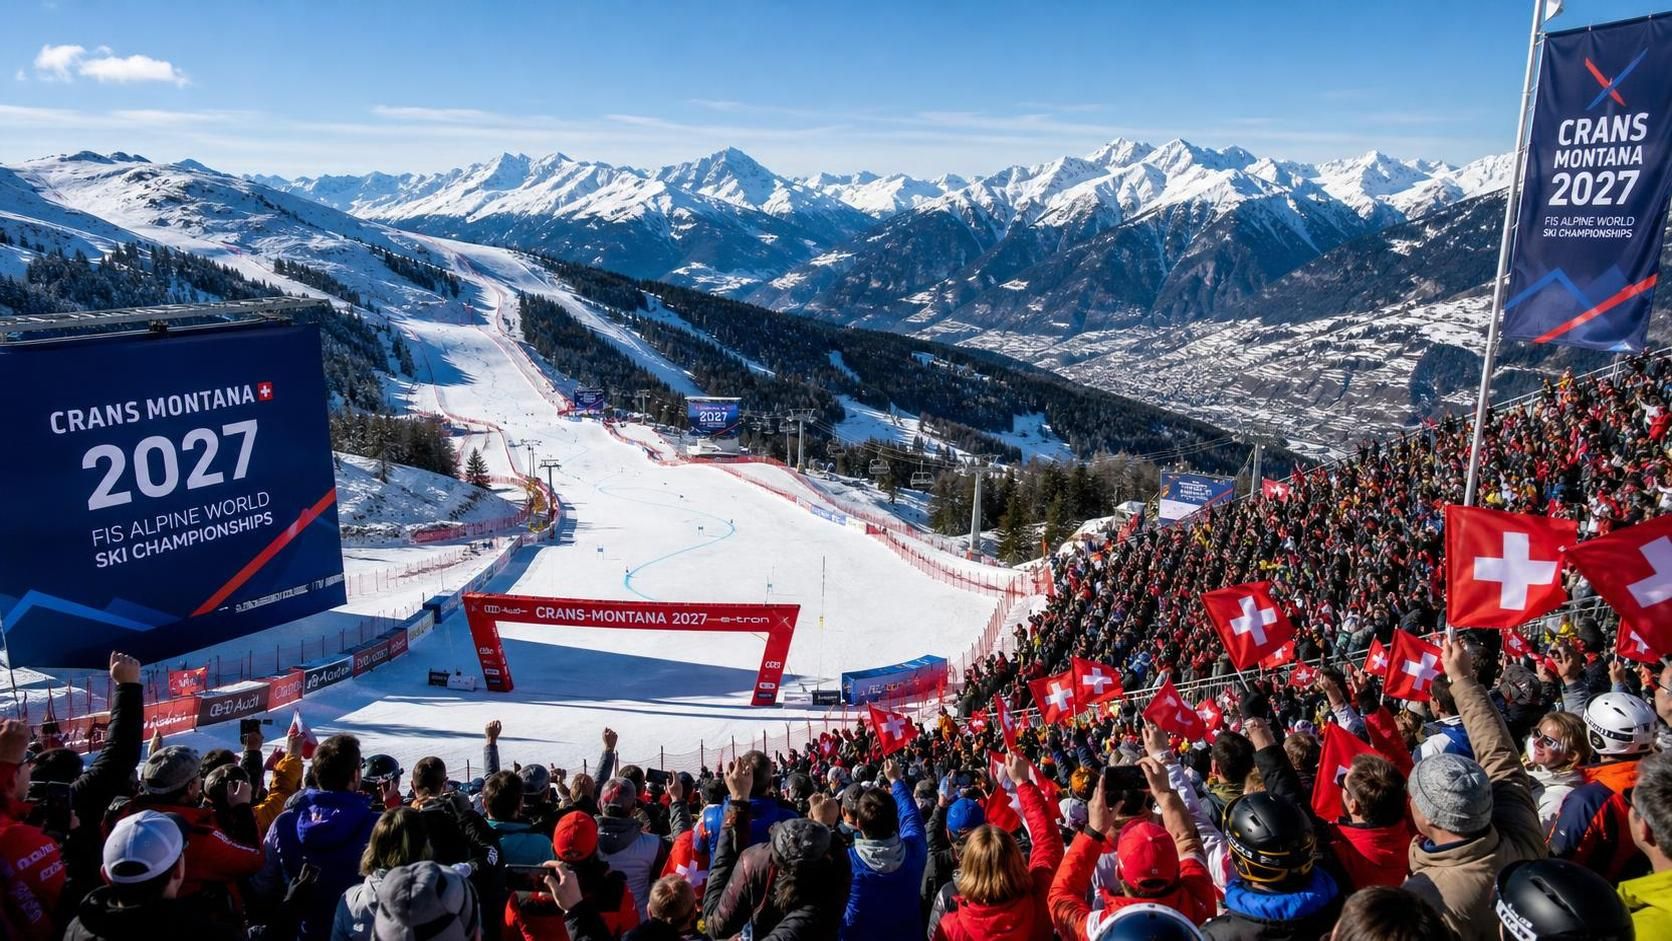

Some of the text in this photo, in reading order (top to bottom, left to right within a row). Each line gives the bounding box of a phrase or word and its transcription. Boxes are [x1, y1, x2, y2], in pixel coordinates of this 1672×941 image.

[1558, 112, 1649, 146] CRANS
[1553, 145, 1643, 169] MONTANA
[1548, 169, 1641, 206] 2027
[1543, 228, 1633, 238] SKI CHAMPIONSHIPS
[1544, 216, 1635, 226] FIS ALPINE WORLD
[50, 384, 255, 434] CRANS MONTANA
[699, 410, 728, 422] 2027
[82, 419, 258, 511] 2027
[92, 491, 270, 547] FIS ALPINE WORLD
[95, 511, 274, 568] SKI CHAMPIONSHIPS
[535, 606, 708, 625] CRANS-MONTANA 2027
[719, 616, 770, 624] e-tron
